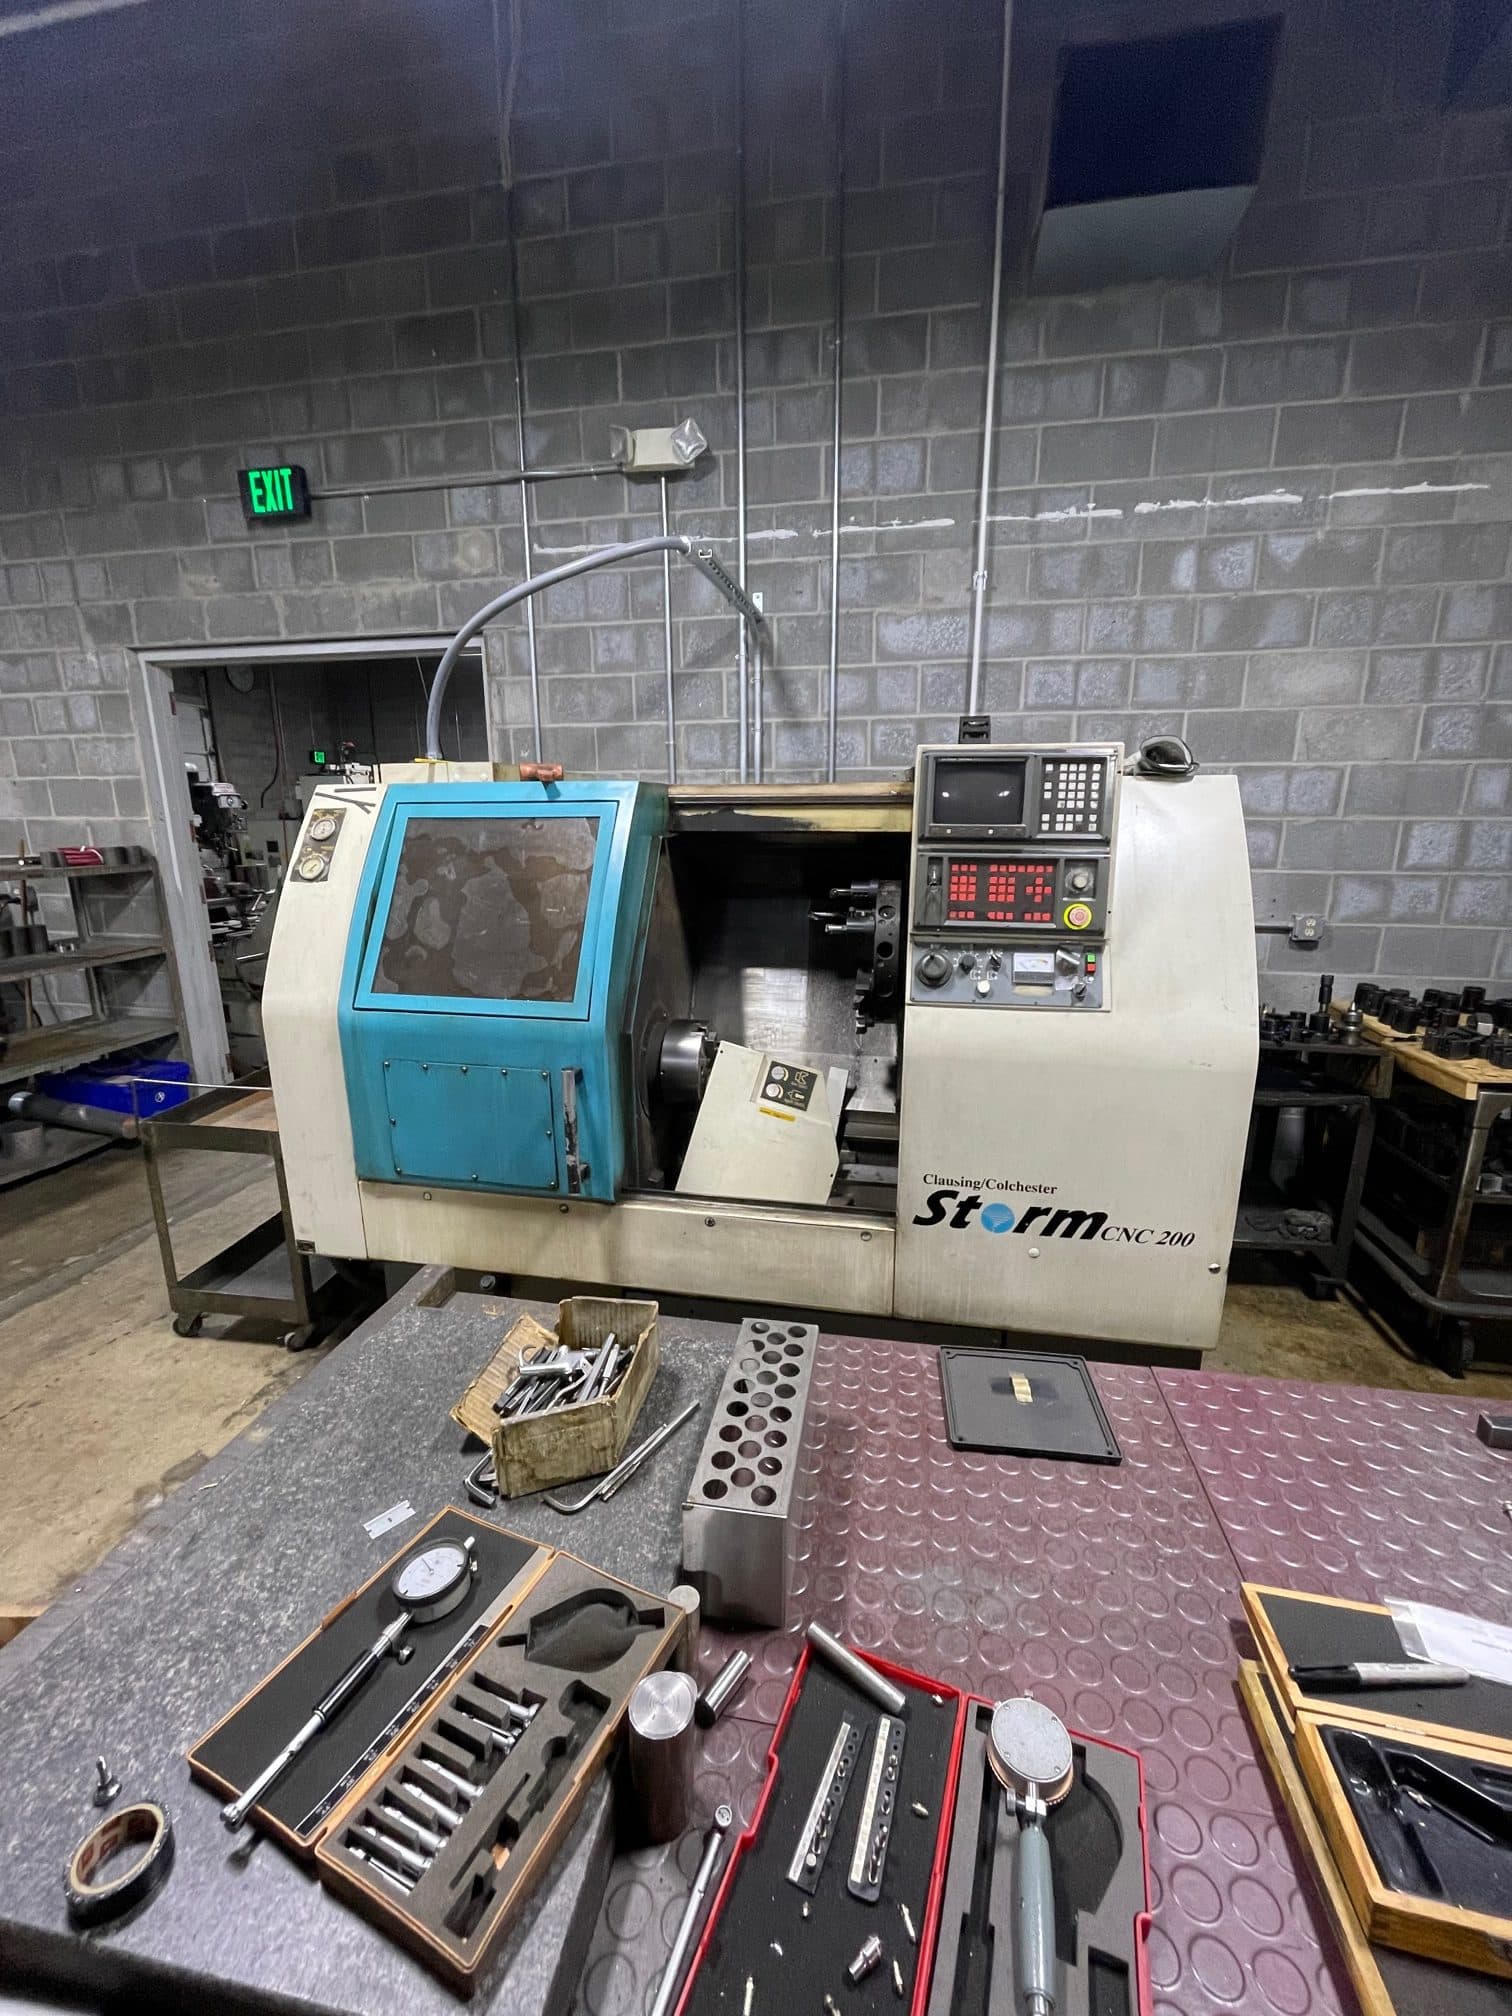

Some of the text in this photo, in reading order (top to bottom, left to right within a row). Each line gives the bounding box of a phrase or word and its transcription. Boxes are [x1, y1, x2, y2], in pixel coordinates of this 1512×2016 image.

[248, 468, 293, 512] EXIT
[923, 1173, 1058, 1195] Clausing/Colchester
[1101, 1226, 1153, 1244] CNC
[1155, 1230, 1195, 1247] 200
